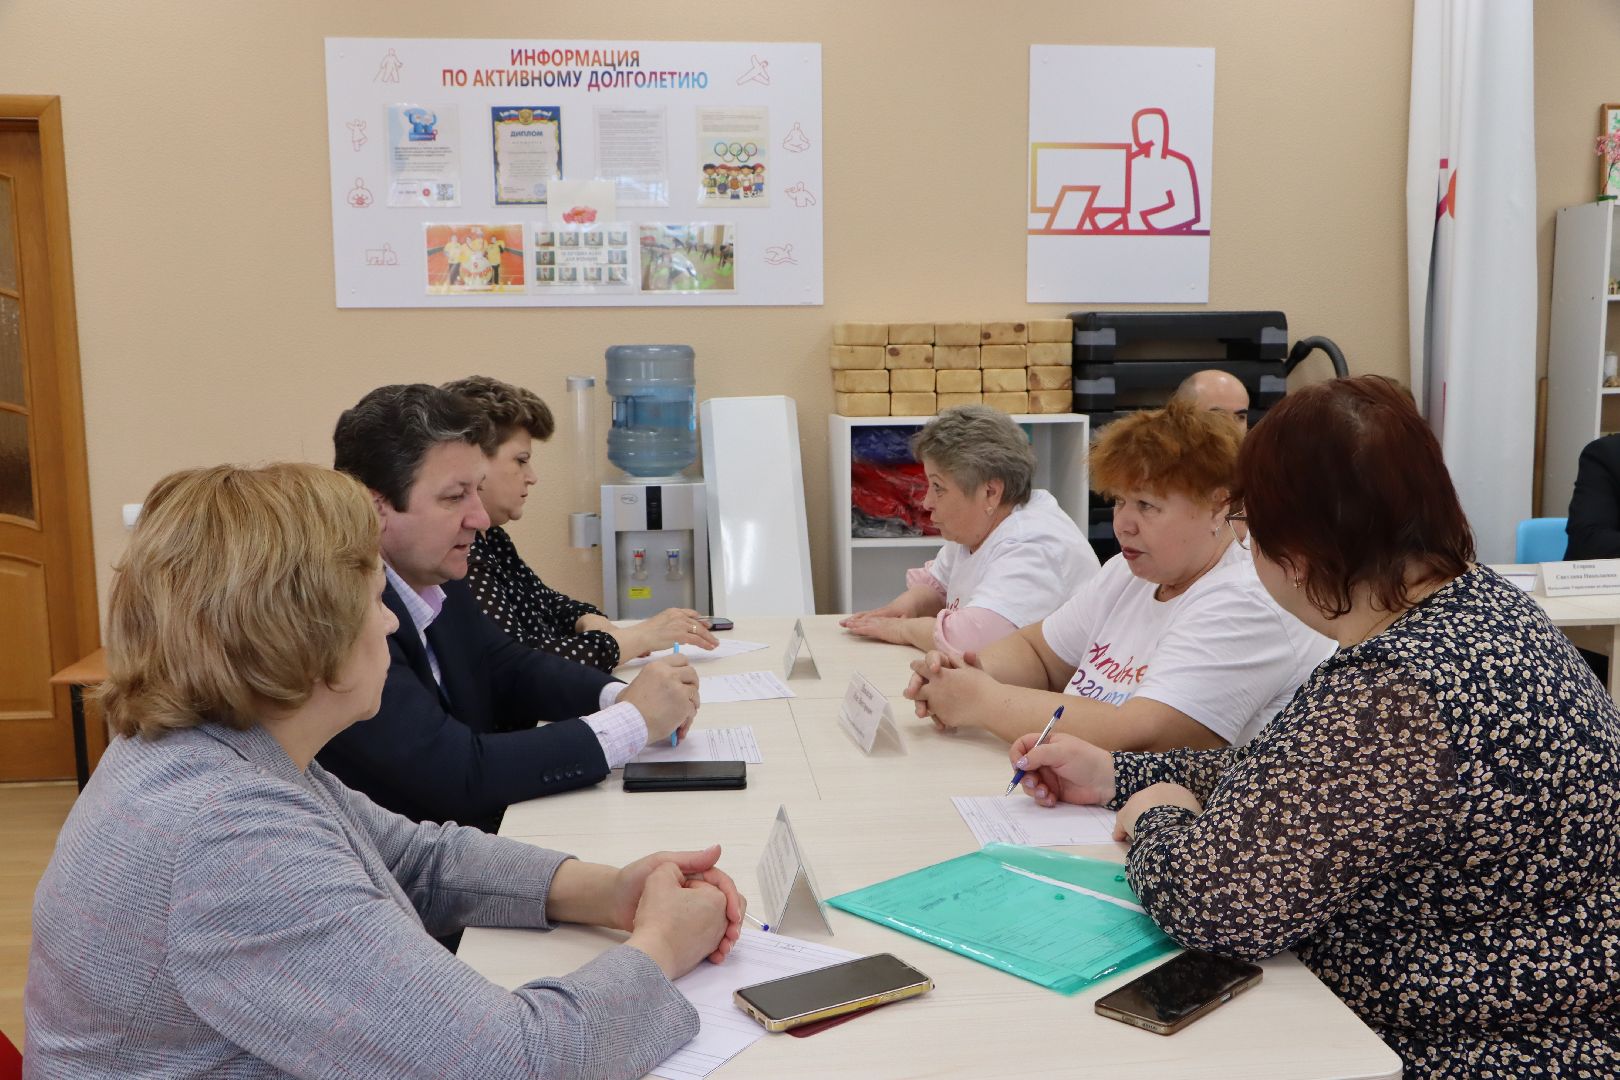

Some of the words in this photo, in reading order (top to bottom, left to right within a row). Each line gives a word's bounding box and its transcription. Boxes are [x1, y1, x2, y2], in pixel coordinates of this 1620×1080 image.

[510, 49, 640, 71] ИНФОРМАЦИЯ
[442, 69, 468, 87] ПО
[472, 69, 582, 88] АКТИВНОМУ
[587, 70, 708, 92] ДОЛГОЛЕТИЮ
